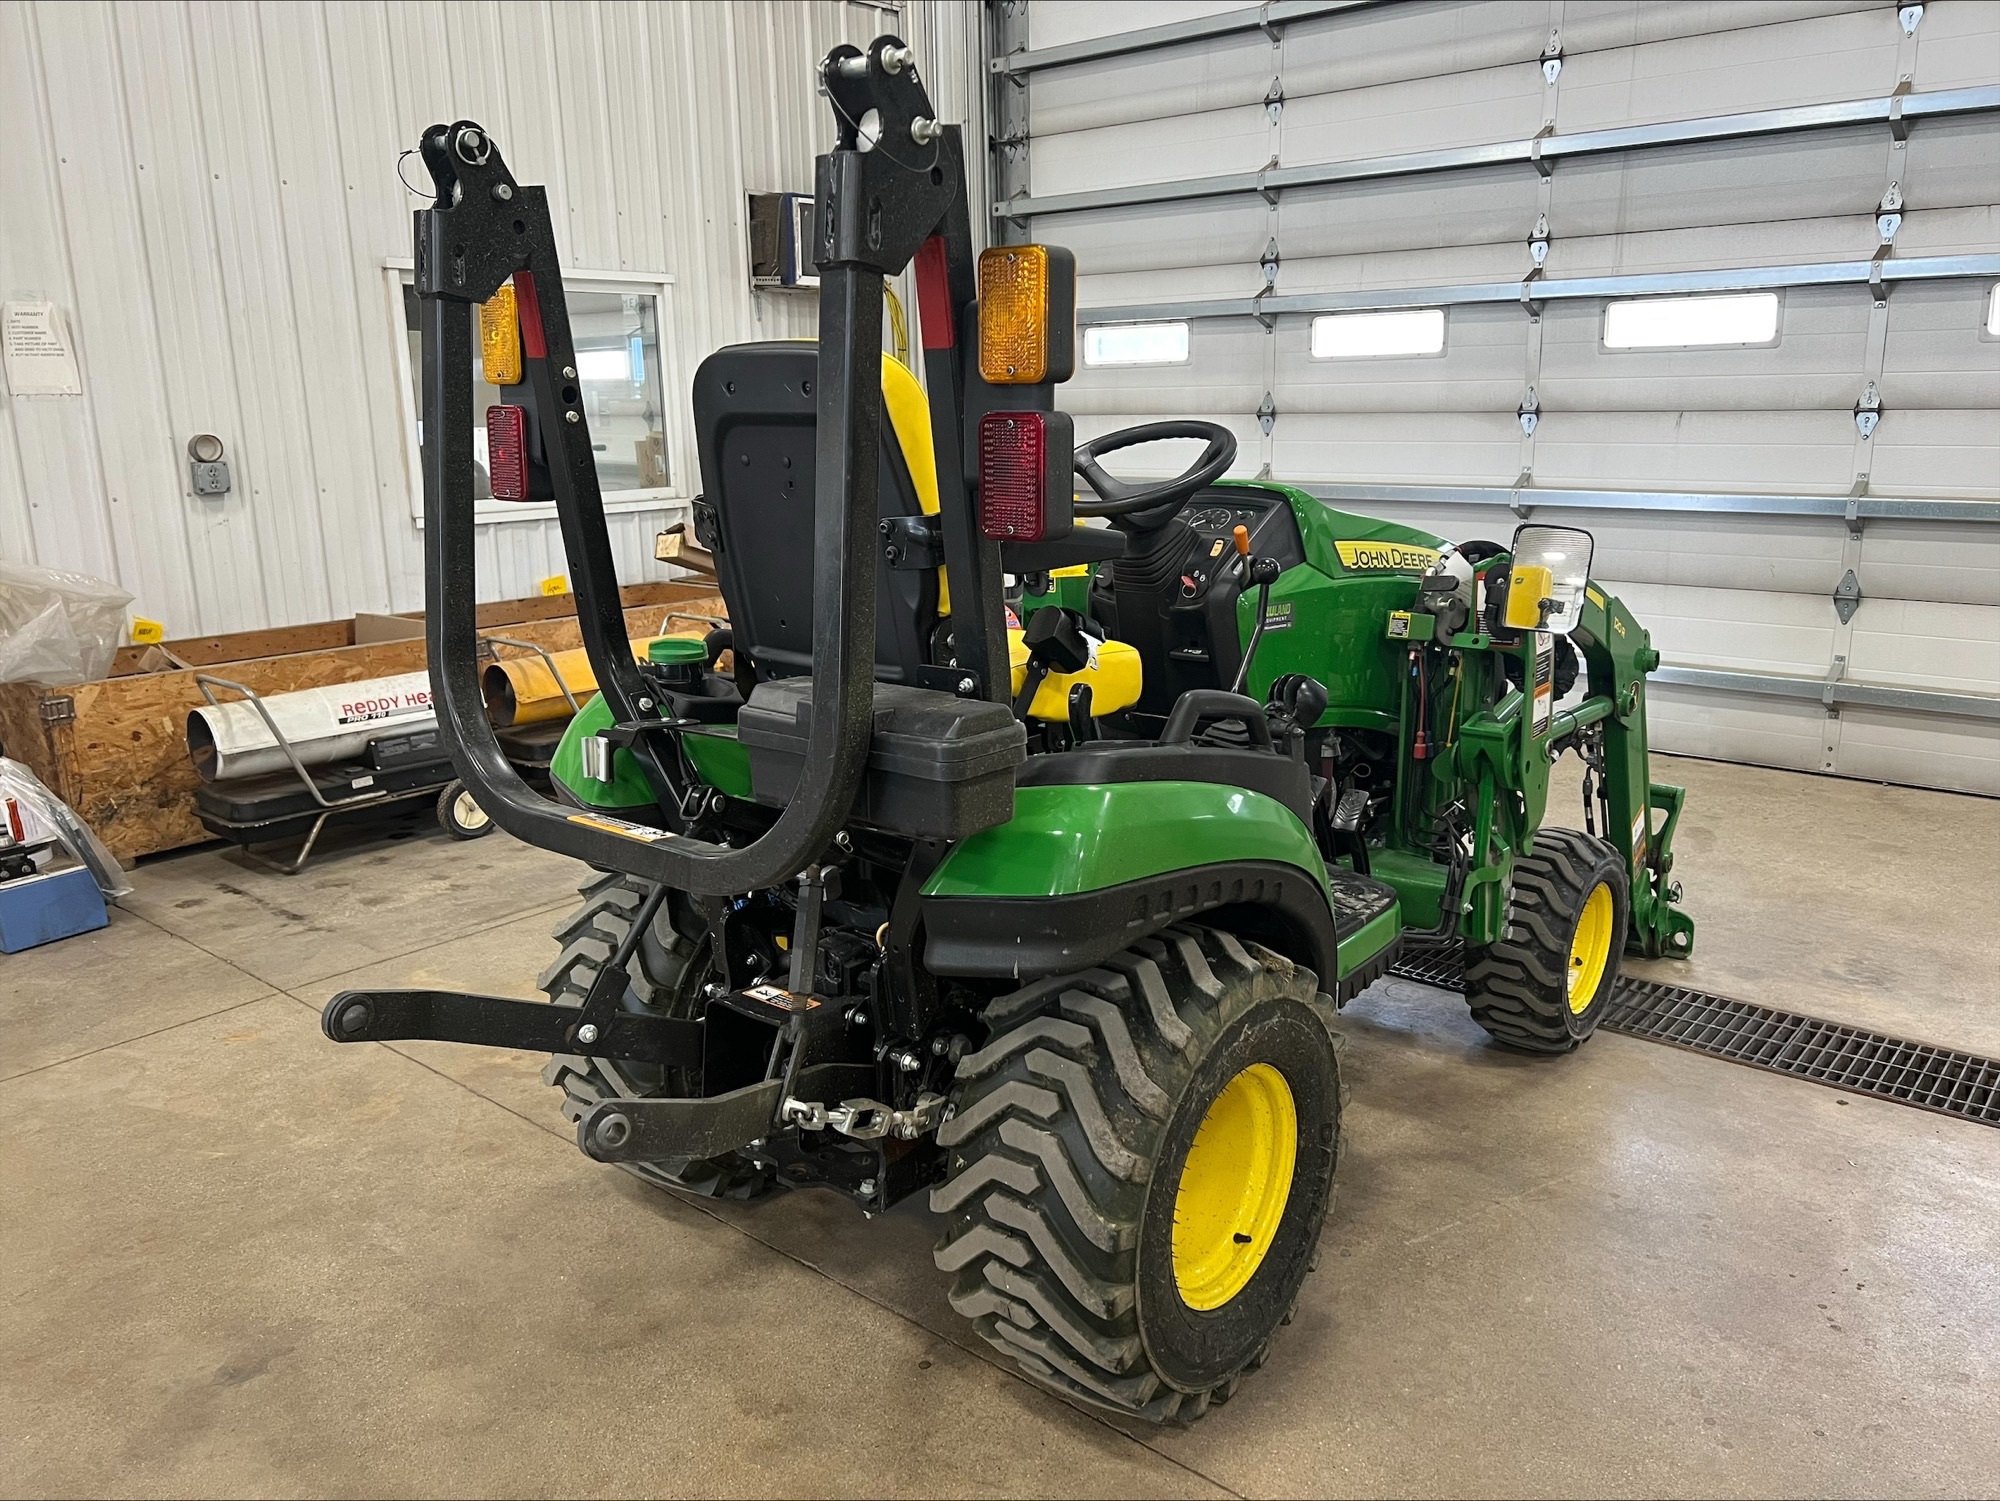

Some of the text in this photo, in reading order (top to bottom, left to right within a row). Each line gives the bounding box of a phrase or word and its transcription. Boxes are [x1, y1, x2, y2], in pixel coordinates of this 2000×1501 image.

[1351, 547, 1432, 567] JOHN DEERE
[347, 712, 387, 723] PRO 110
